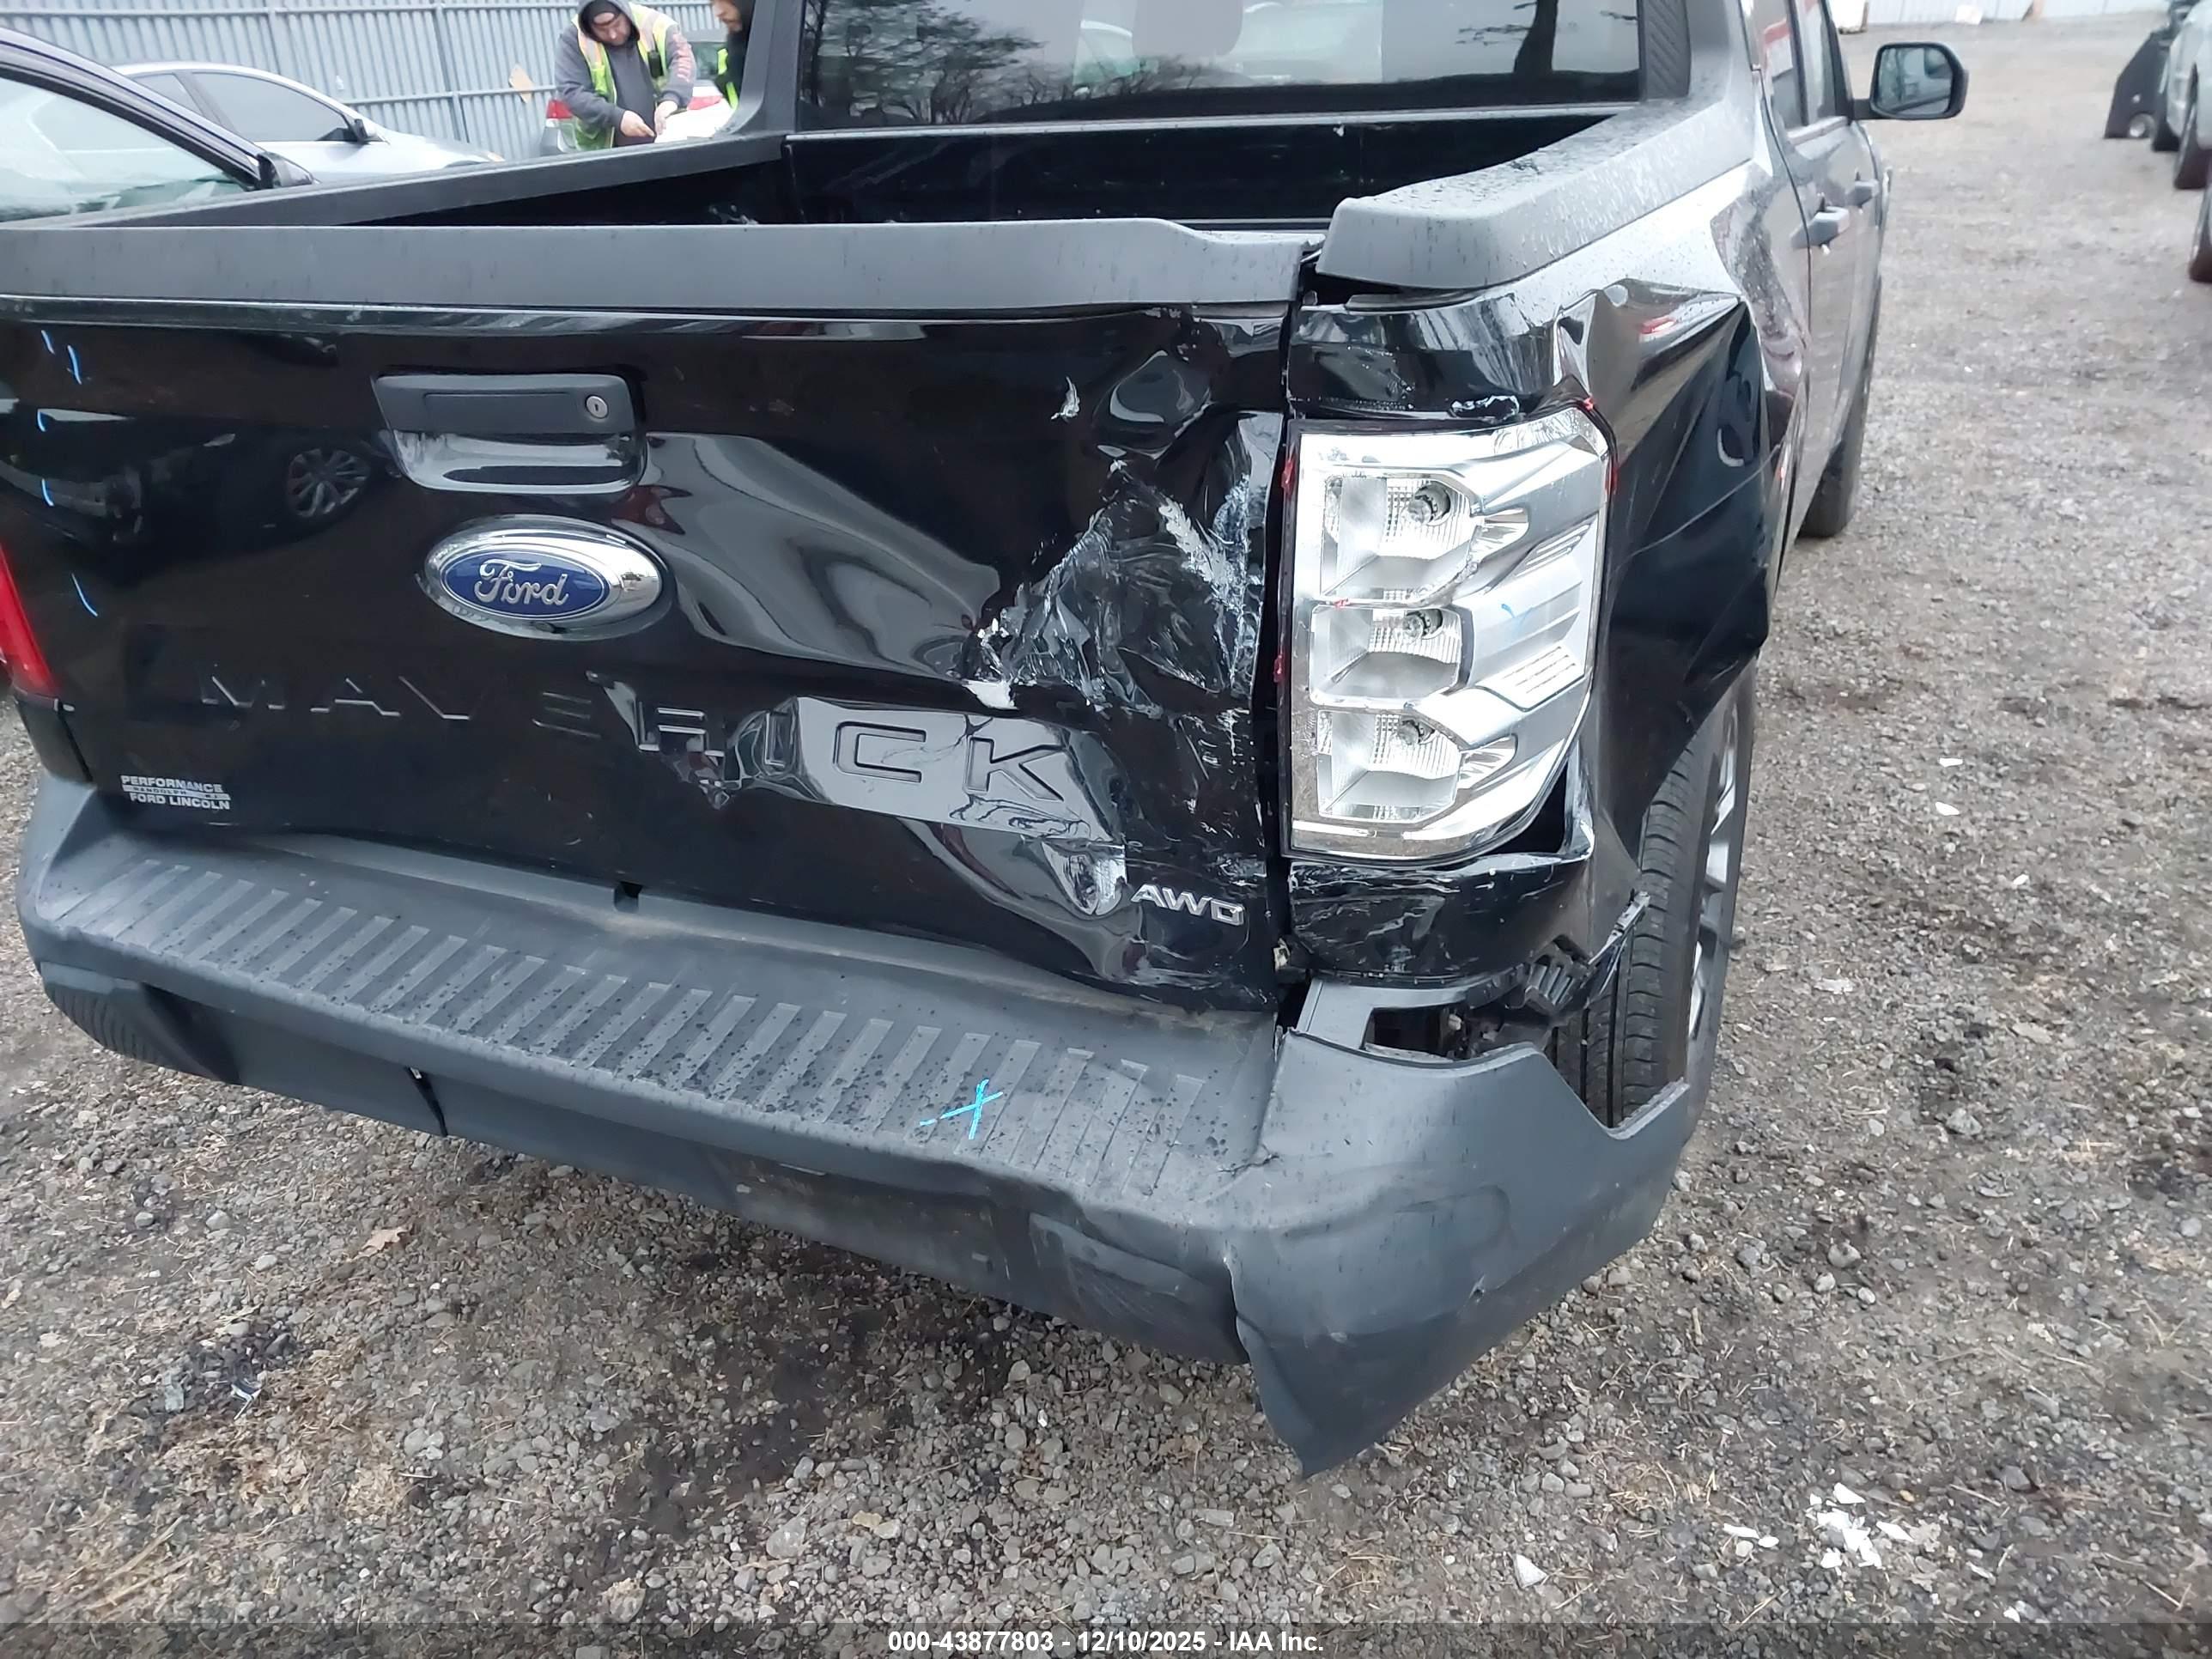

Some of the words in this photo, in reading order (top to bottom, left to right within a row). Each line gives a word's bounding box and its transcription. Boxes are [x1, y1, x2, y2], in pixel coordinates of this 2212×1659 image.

[474, 559, 569, 605] Ford
[120, 775, 224, 793] PERFORMANCE
[130, 793, 167, 804] FORD
[169, 796, 230, 810] LINCOLN
[1130, 884, 1244, 926] AWD
